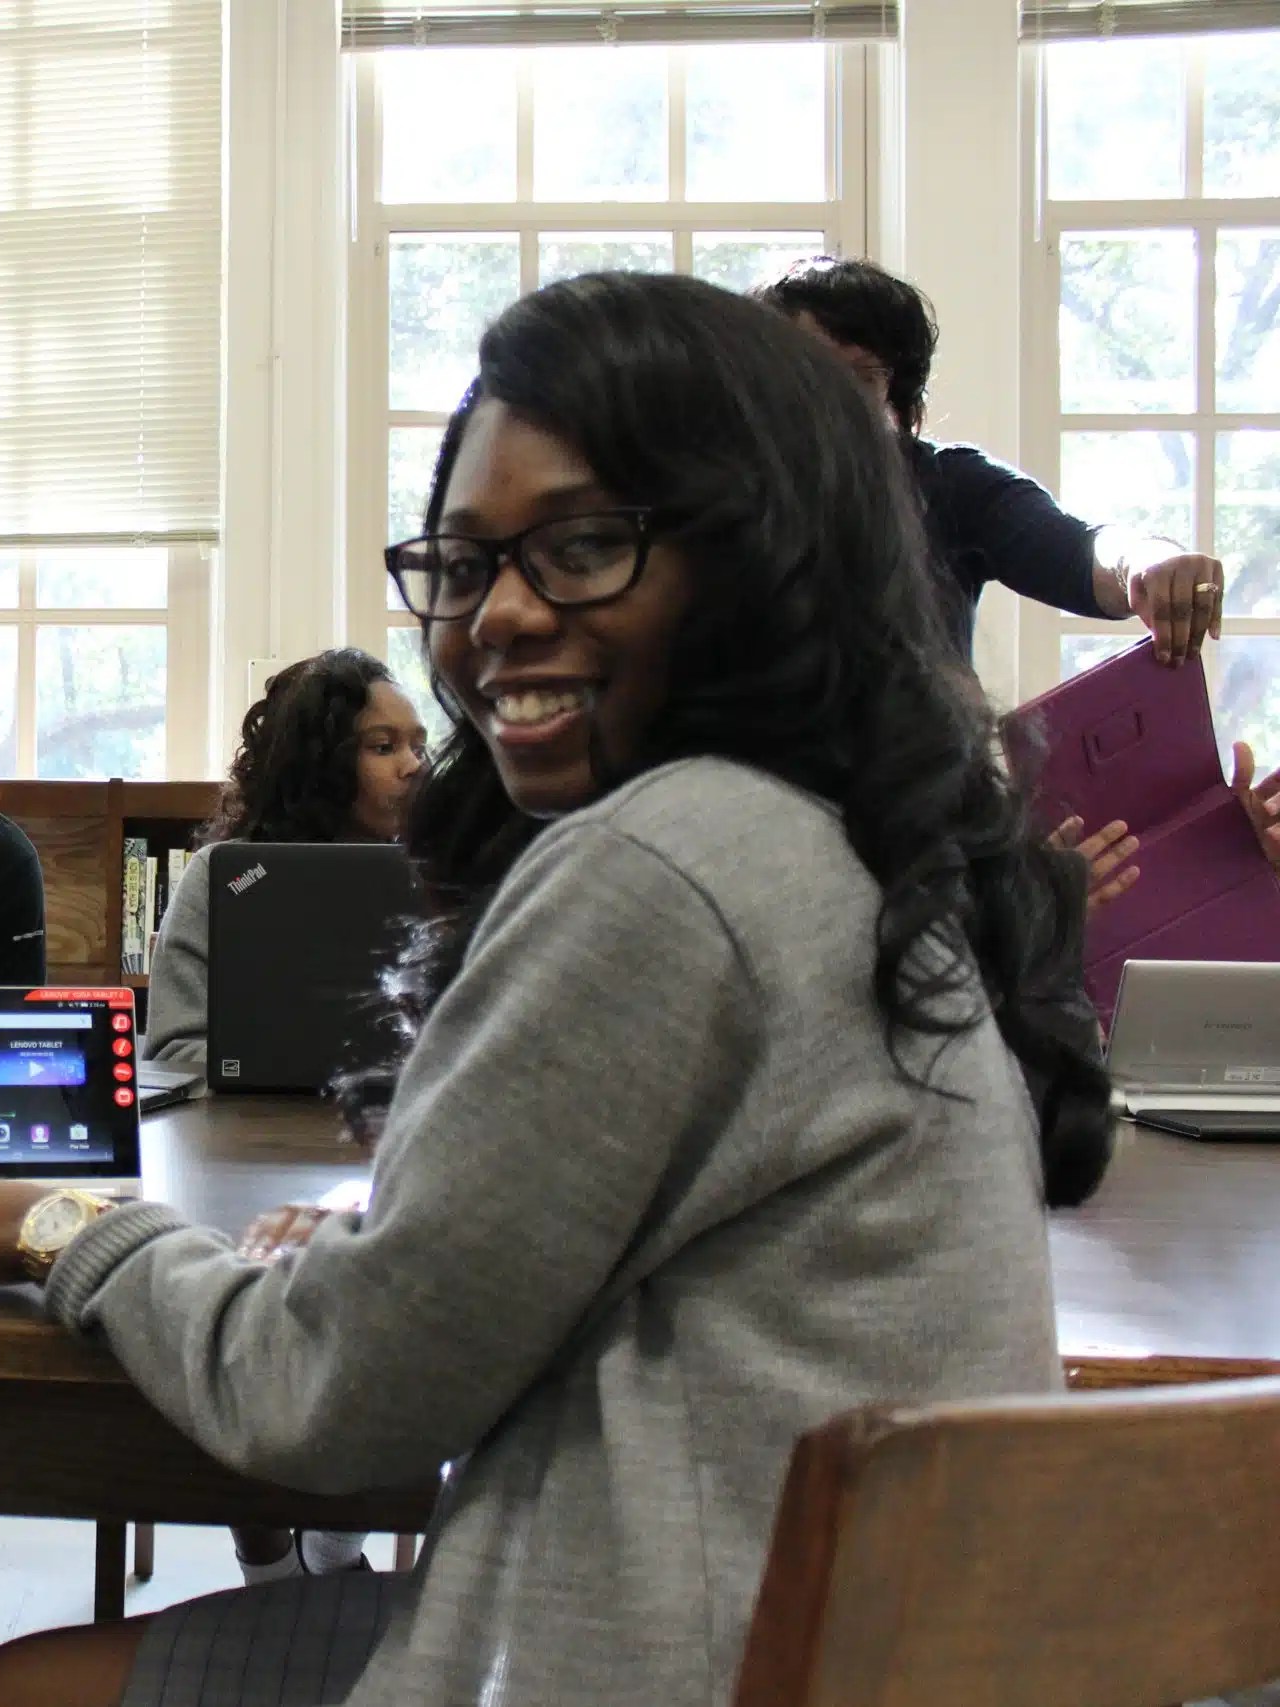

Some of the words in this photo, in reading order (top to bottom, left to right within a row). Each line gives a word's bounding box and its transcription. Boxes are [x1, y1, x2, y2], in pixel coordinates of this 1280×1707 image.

[227, 862, 267, 895] ThinkPad
[10, 1041, 38, 1049] LENOVO
[39, 1041, 63, 1049] TABLET
